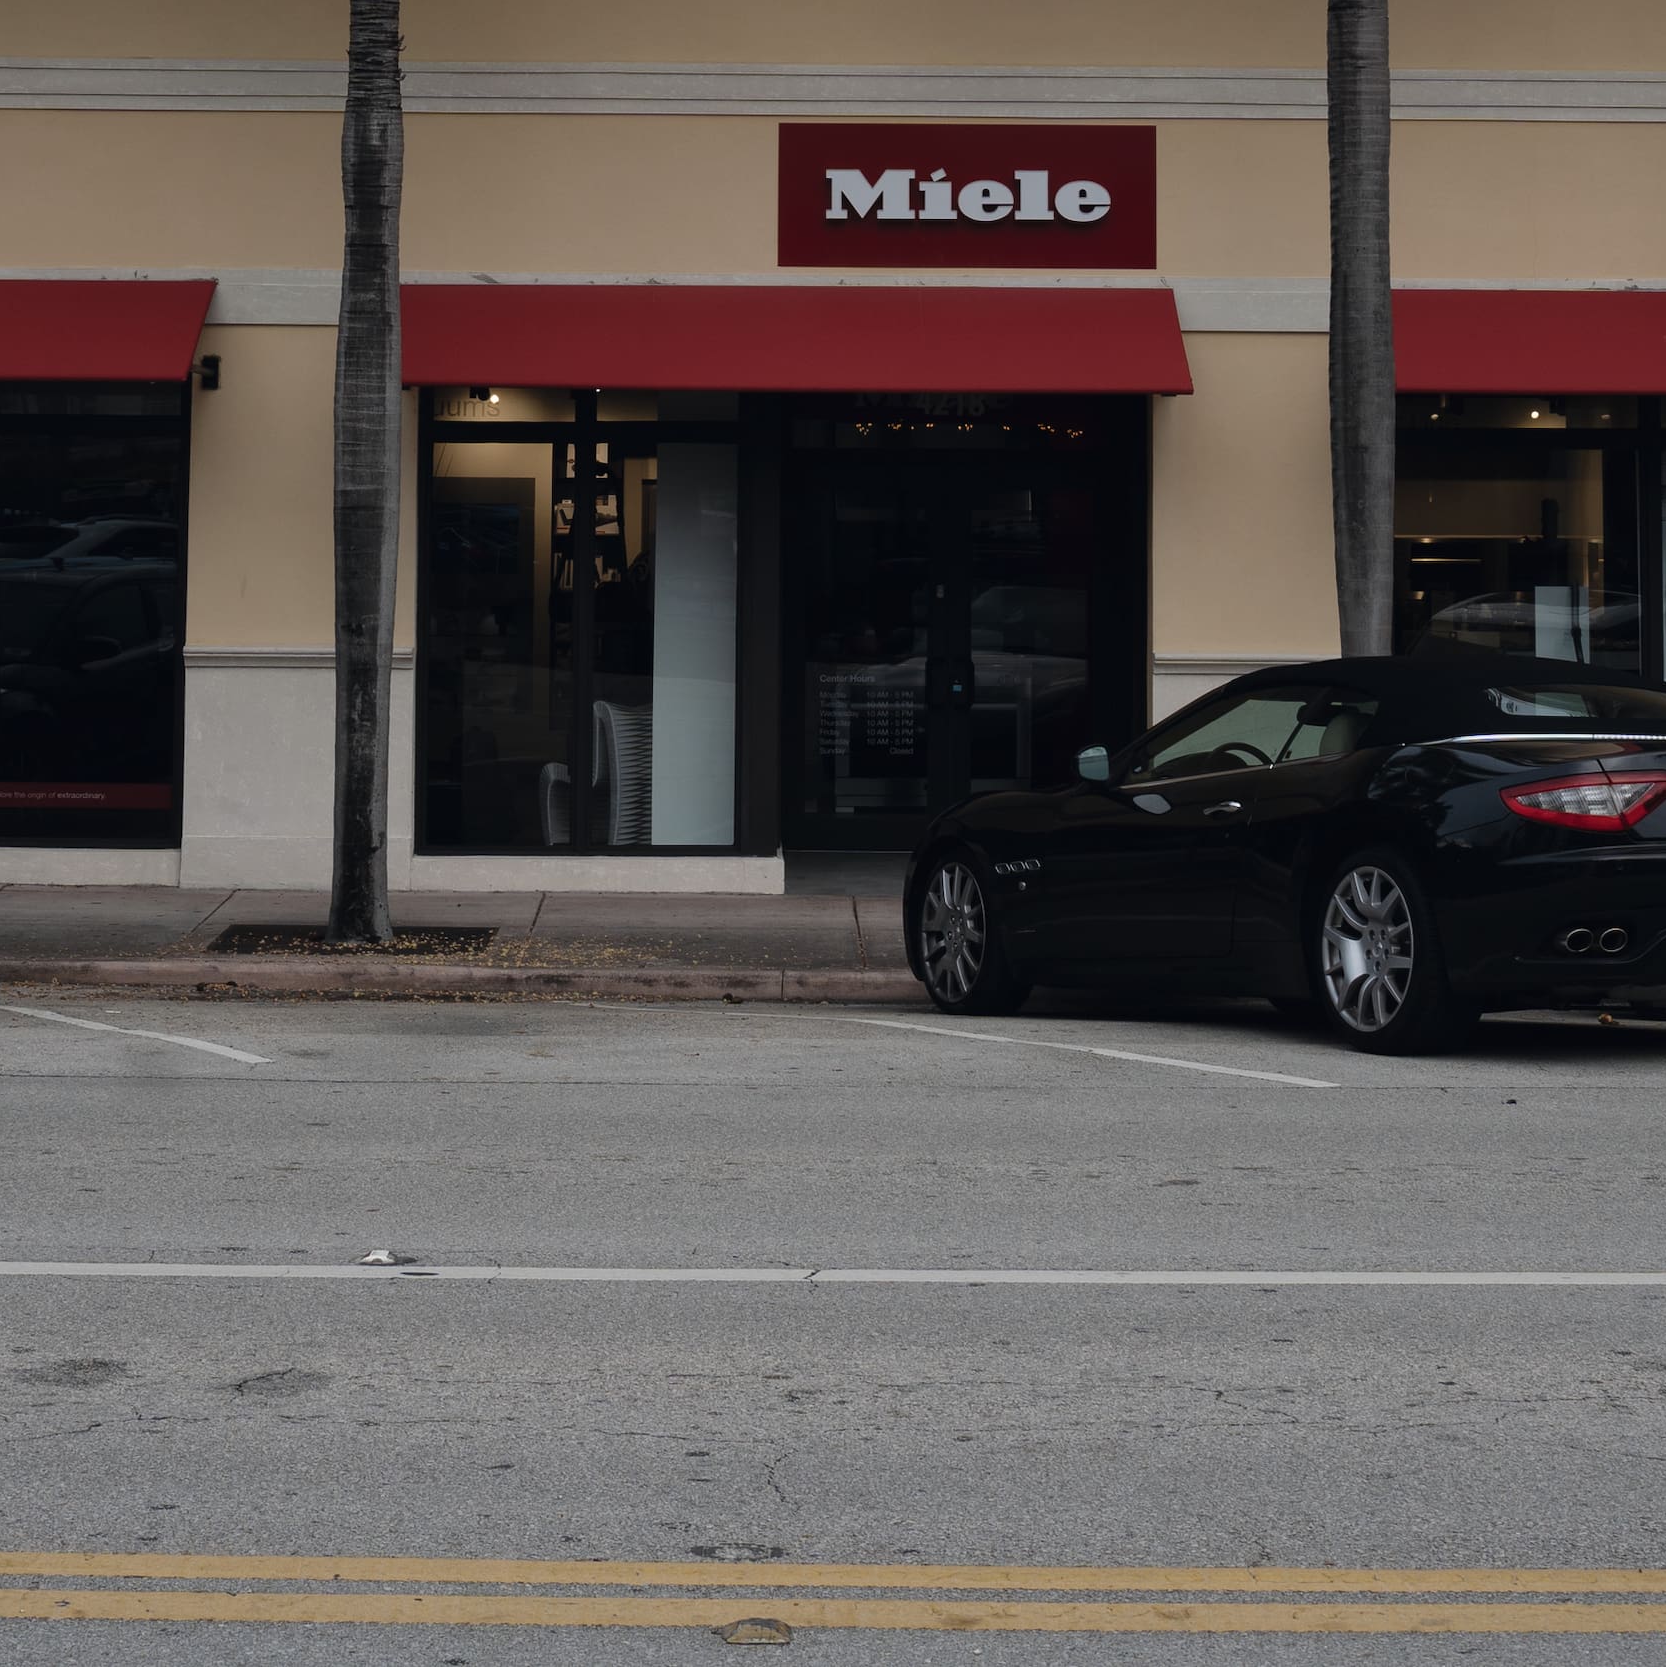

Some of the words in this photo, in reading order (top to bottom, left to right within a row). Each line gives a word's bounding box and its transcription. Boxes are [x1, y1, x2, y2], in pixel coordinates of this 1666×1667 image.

[825, 167, 1112, 223] Miele
[819, 674, 848, 683] Center
[850, 674, 876, 683] Hours
[14, 790, 26, 799] the
[27, 791, 46, 801] origin
